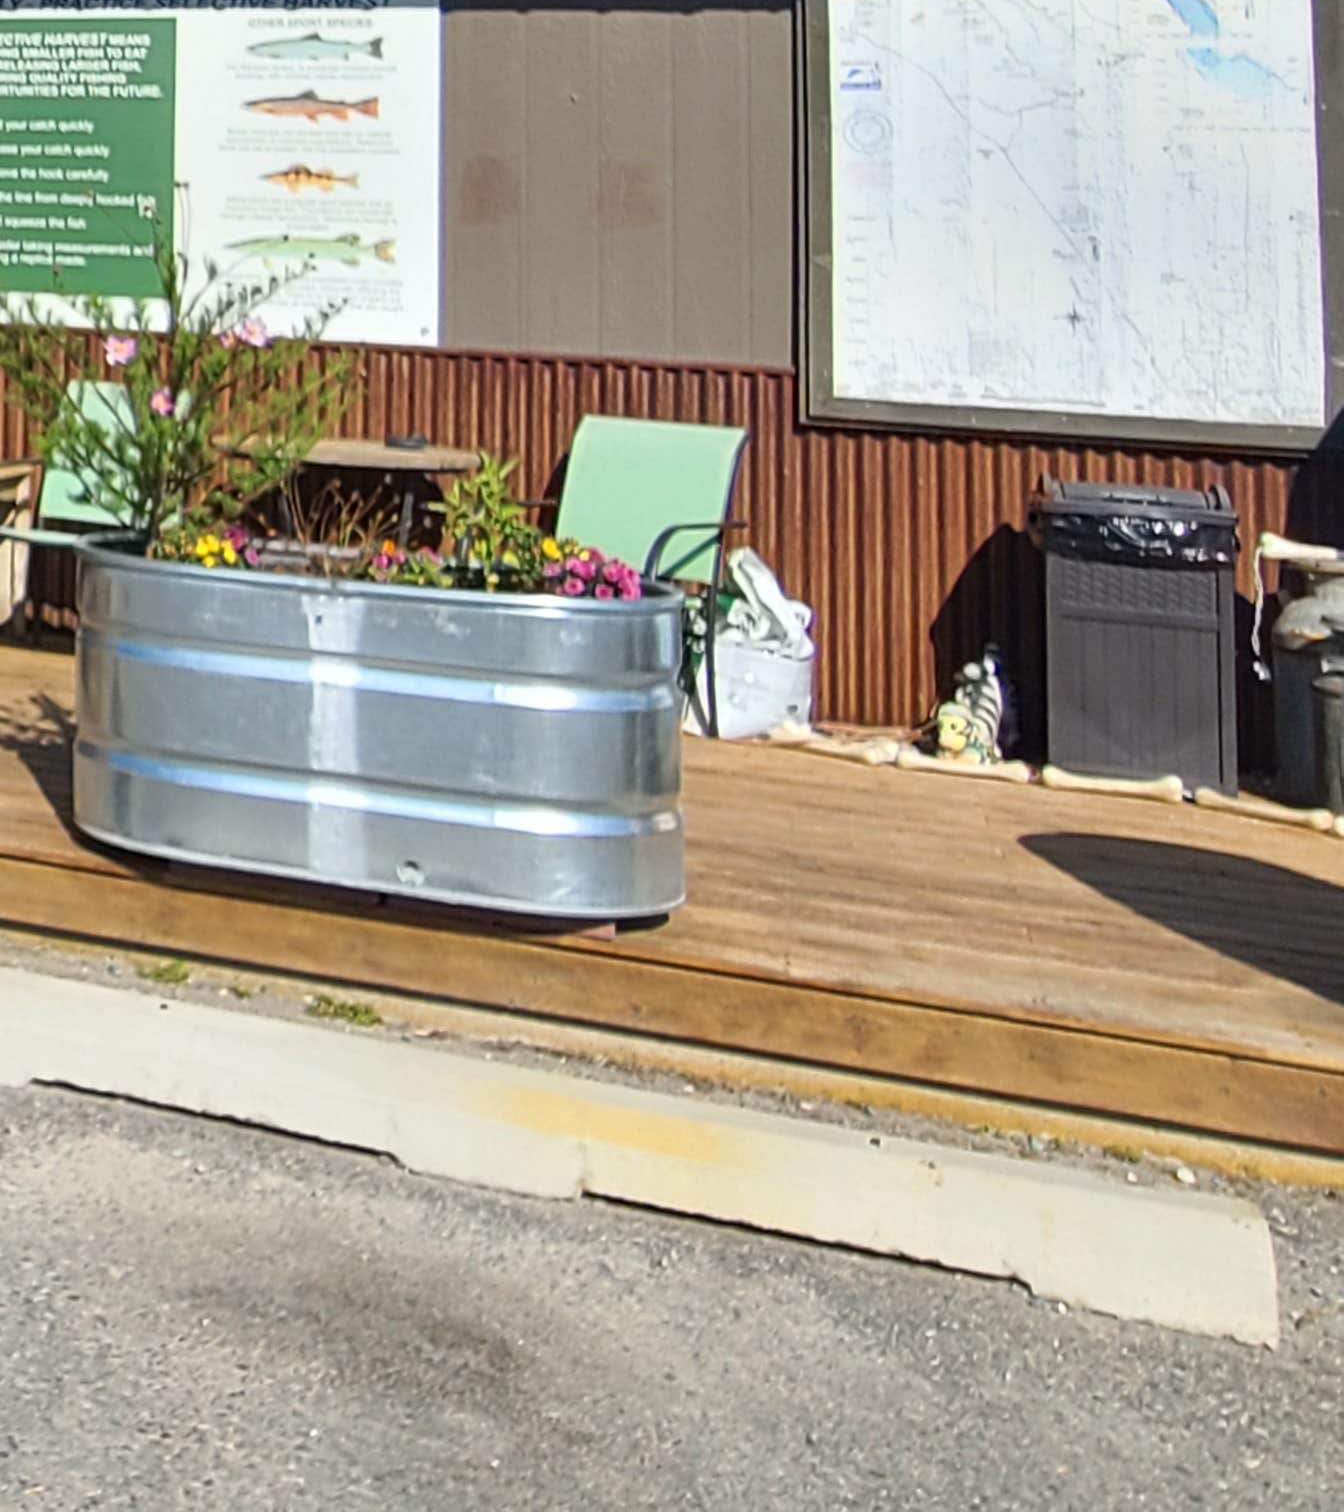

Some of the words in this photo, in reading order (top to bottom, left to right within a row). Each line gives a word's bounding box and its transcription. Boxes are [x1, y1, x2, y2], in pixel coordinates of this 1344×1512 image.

[44, 32, 108, 47] HARVEST
[108, 33, 151, 47] MEANS
[22, 47, 76, 59] SMALLER
[77, 47, 104, 59] FISH
[106, 48, 123, 59] TO
[124, 48, 148, 60] EAT
[61, 60, 109, 72] LARGER
[29, 72, 78, 85] QUALITY
[79, 73, 127, 85] FISHING
[61, 84, 86, 97] FOR
[88, 85, 111, 97] THE
[5, 120, 28, 132] your
[29, 119, 57, 131] catch
[58, 119, 95, 133] quickly
[20, 144, 42, 157] your
[44, 144, 72, 156] catch
[74, 144, 110, 158] quickly
[20, 167, 36, 178] the
[38, 167, 64, 179] hook
[66, 168, 109, 182] carefully
[15, 191, 33, 204] line
[35, 191, 58, 204] from
[96, 194, 135, 207] hooked
[4, 216, 47, 229] squeeze
[48, 216, 65, 229] the
[67, 216, 87, 229] fish
[22, 240, 53, 254] taking
[54, 242, 131, 256] measurements
[132, 244, 155, 257] and
